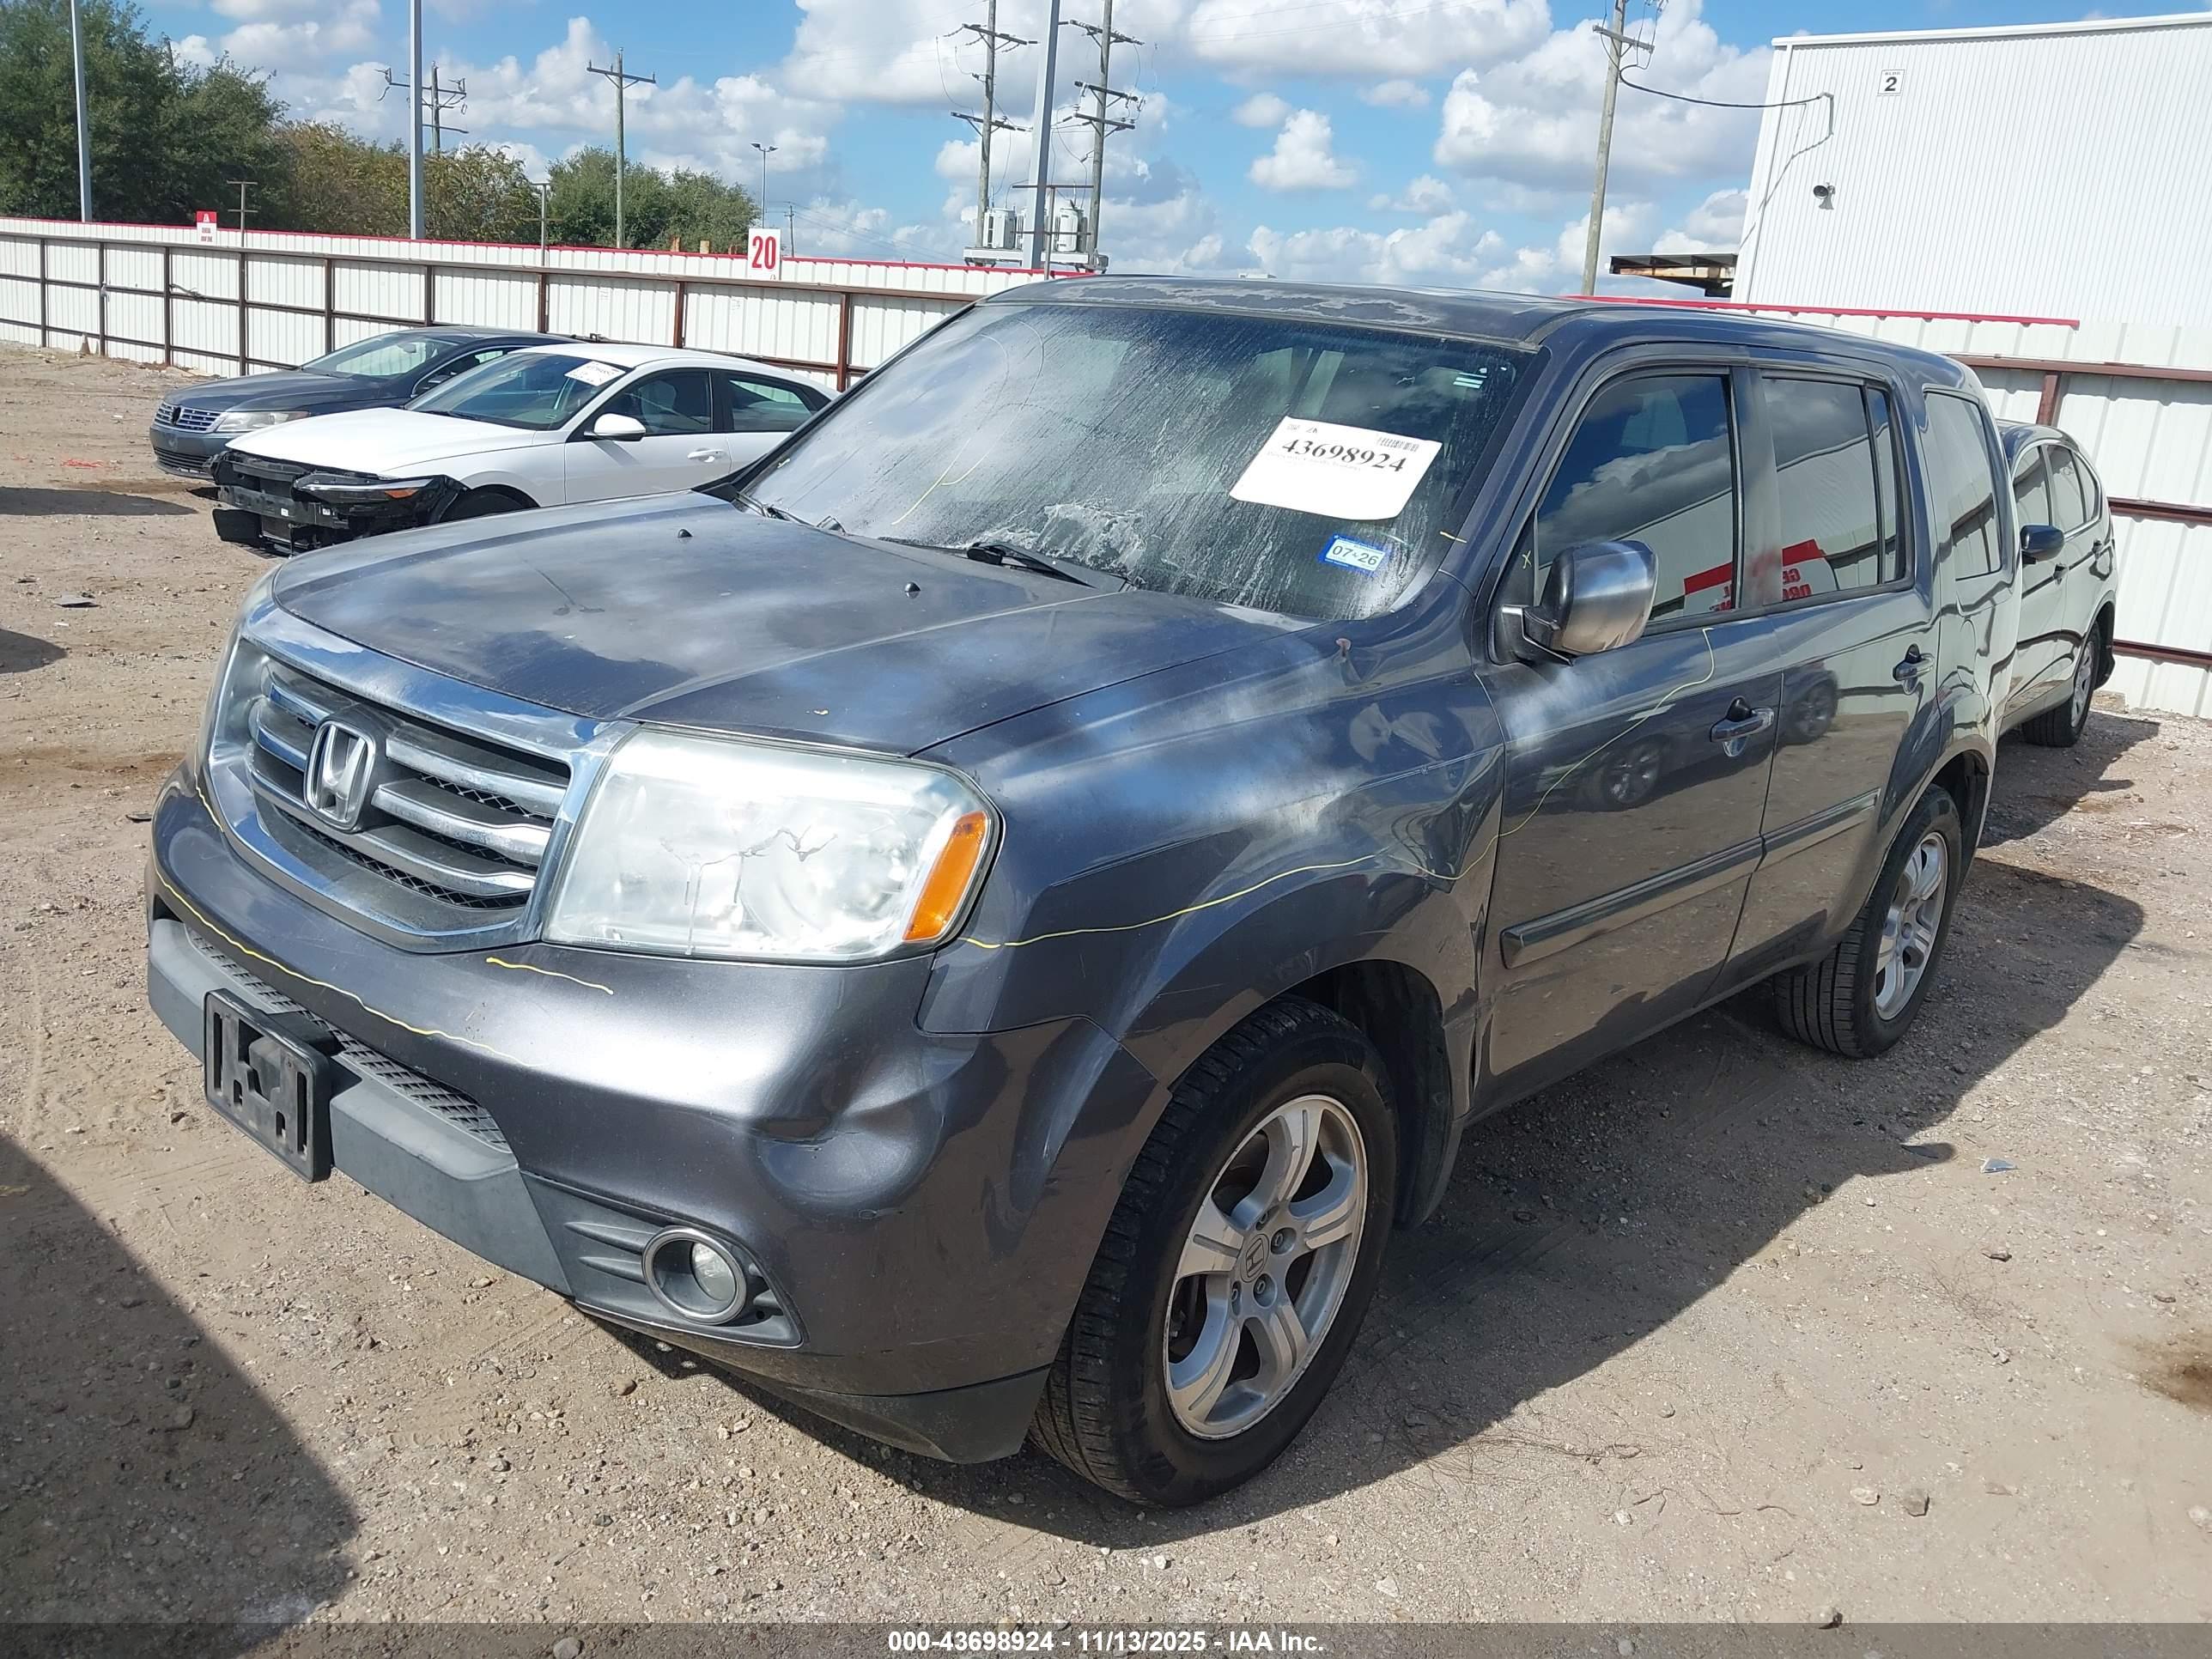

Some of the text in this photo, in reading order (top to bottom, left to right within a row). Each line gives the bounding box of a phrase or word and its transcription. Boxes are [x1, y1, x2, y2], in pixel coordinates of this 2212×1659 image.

[1884, 76, 1898, 92] 2
[751, 235, 776, 270] 20
[1281, 439, 1407, 472] 43698924
[1332, 545, 1379, 565] 07 26
